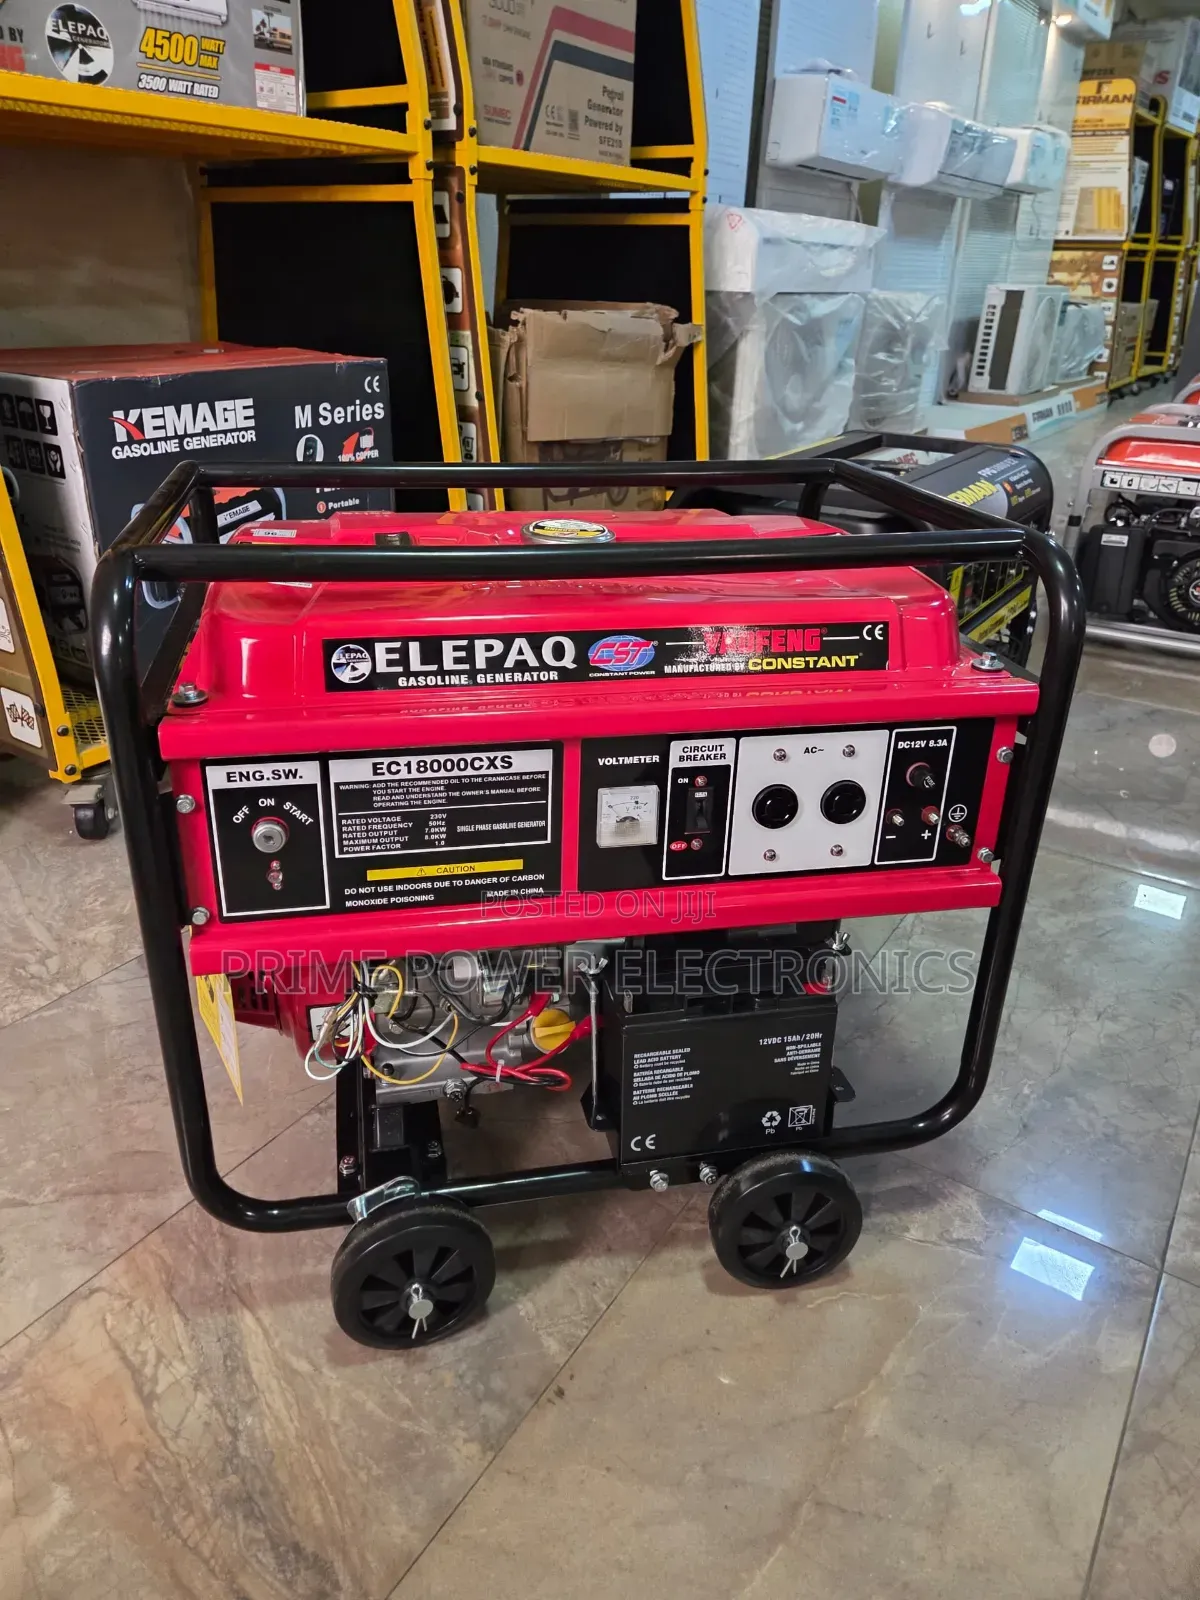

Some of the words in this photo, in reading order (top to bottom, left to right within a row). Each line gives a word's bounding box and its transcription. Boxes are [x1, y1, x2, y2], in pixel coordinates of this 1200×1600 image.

[8, 27, 23, 42] BY
[51, 19, 108, 40] ELEPAQ
[139, 27, 199, 66] 4500
[200, 36, 226, 54] WATT
[199, 54, 220, 70] MAX
[138, 74, 167, 92] 3500
[168, 78, 193, 95] WATT
[194, 83, 220, 98] RATED
[584, 116, 613, 131] Powered
[364, 376, 380, 393] CE
[109, 398, 256, 442] KEMAGE
[294, 404, 312, 429] M
[318, 400, 384, 426] Series
[112, 439, 180, 460] GASOLINE
[184, 430, 256, 450] GENERATOR
[356, 450, 379, 460] COPPER
[947, 480, 999, 506] RMAN
[328, 498, 360, 510] Portable
[863, 624, 884, 640] CE
[374, 636, 578, 672] ELEPAQ
[590, 640, 654, 665] CST
[664, 662, 732, 674] MANUFACTURED
[748, 655, 859, 670] CONSTANT
[398, 675, 468, 687] GASOLINE
[477, 671, 558, 684] GENERATOR
[682, 744, 724, 754] CIRCUIT
[898, 740, 926, 749] DC12V
[929, 739, 948, 747] 8.3A
[372, 754, 514, 776] EC18000CXS
[598, 755, 660, 766] VOLTMETER
[678, 753, 726, 762] BREAKER
[226, 768, 303, 782] ENG.SW.
[401, 779, 448, 787] RECOMMENDED
[406, 792, 447, 800] UNDERSTAND
[373, 800, 409, 808] OPERATING
[232, 805, 250, 824] OFF
[258, 798, 274, 806] ON
[283, 802, 314, 826] START
[368, 822, 413, 830] FREQUENCY
[493, 822, 516, 830] GASOLINE
[343, 838, 378, 846] MAXIMUM
[436, 866, 476, 874] CAUTION
[359, 886, 376, 894] NOT
[395, 882, 432, 891] INDOORS
[452, 879, 463, 887] TO
[465, 877, 498, 886] DANGER
[512, 874, 545, 882] CARBON
[520, 887, 544, 895] CHINA
[346, 898, 389, 908] MONOXIDE
[390, 894, 434, 904] POISONING
[759, 1037, 782, 1045] 12VDC
[786, 1042, 821, 1051] NON-SPILLABLE
[634, 1050, 671, 1058] RECHARGEABLE
[630, 1134, 656, 1152] CE
